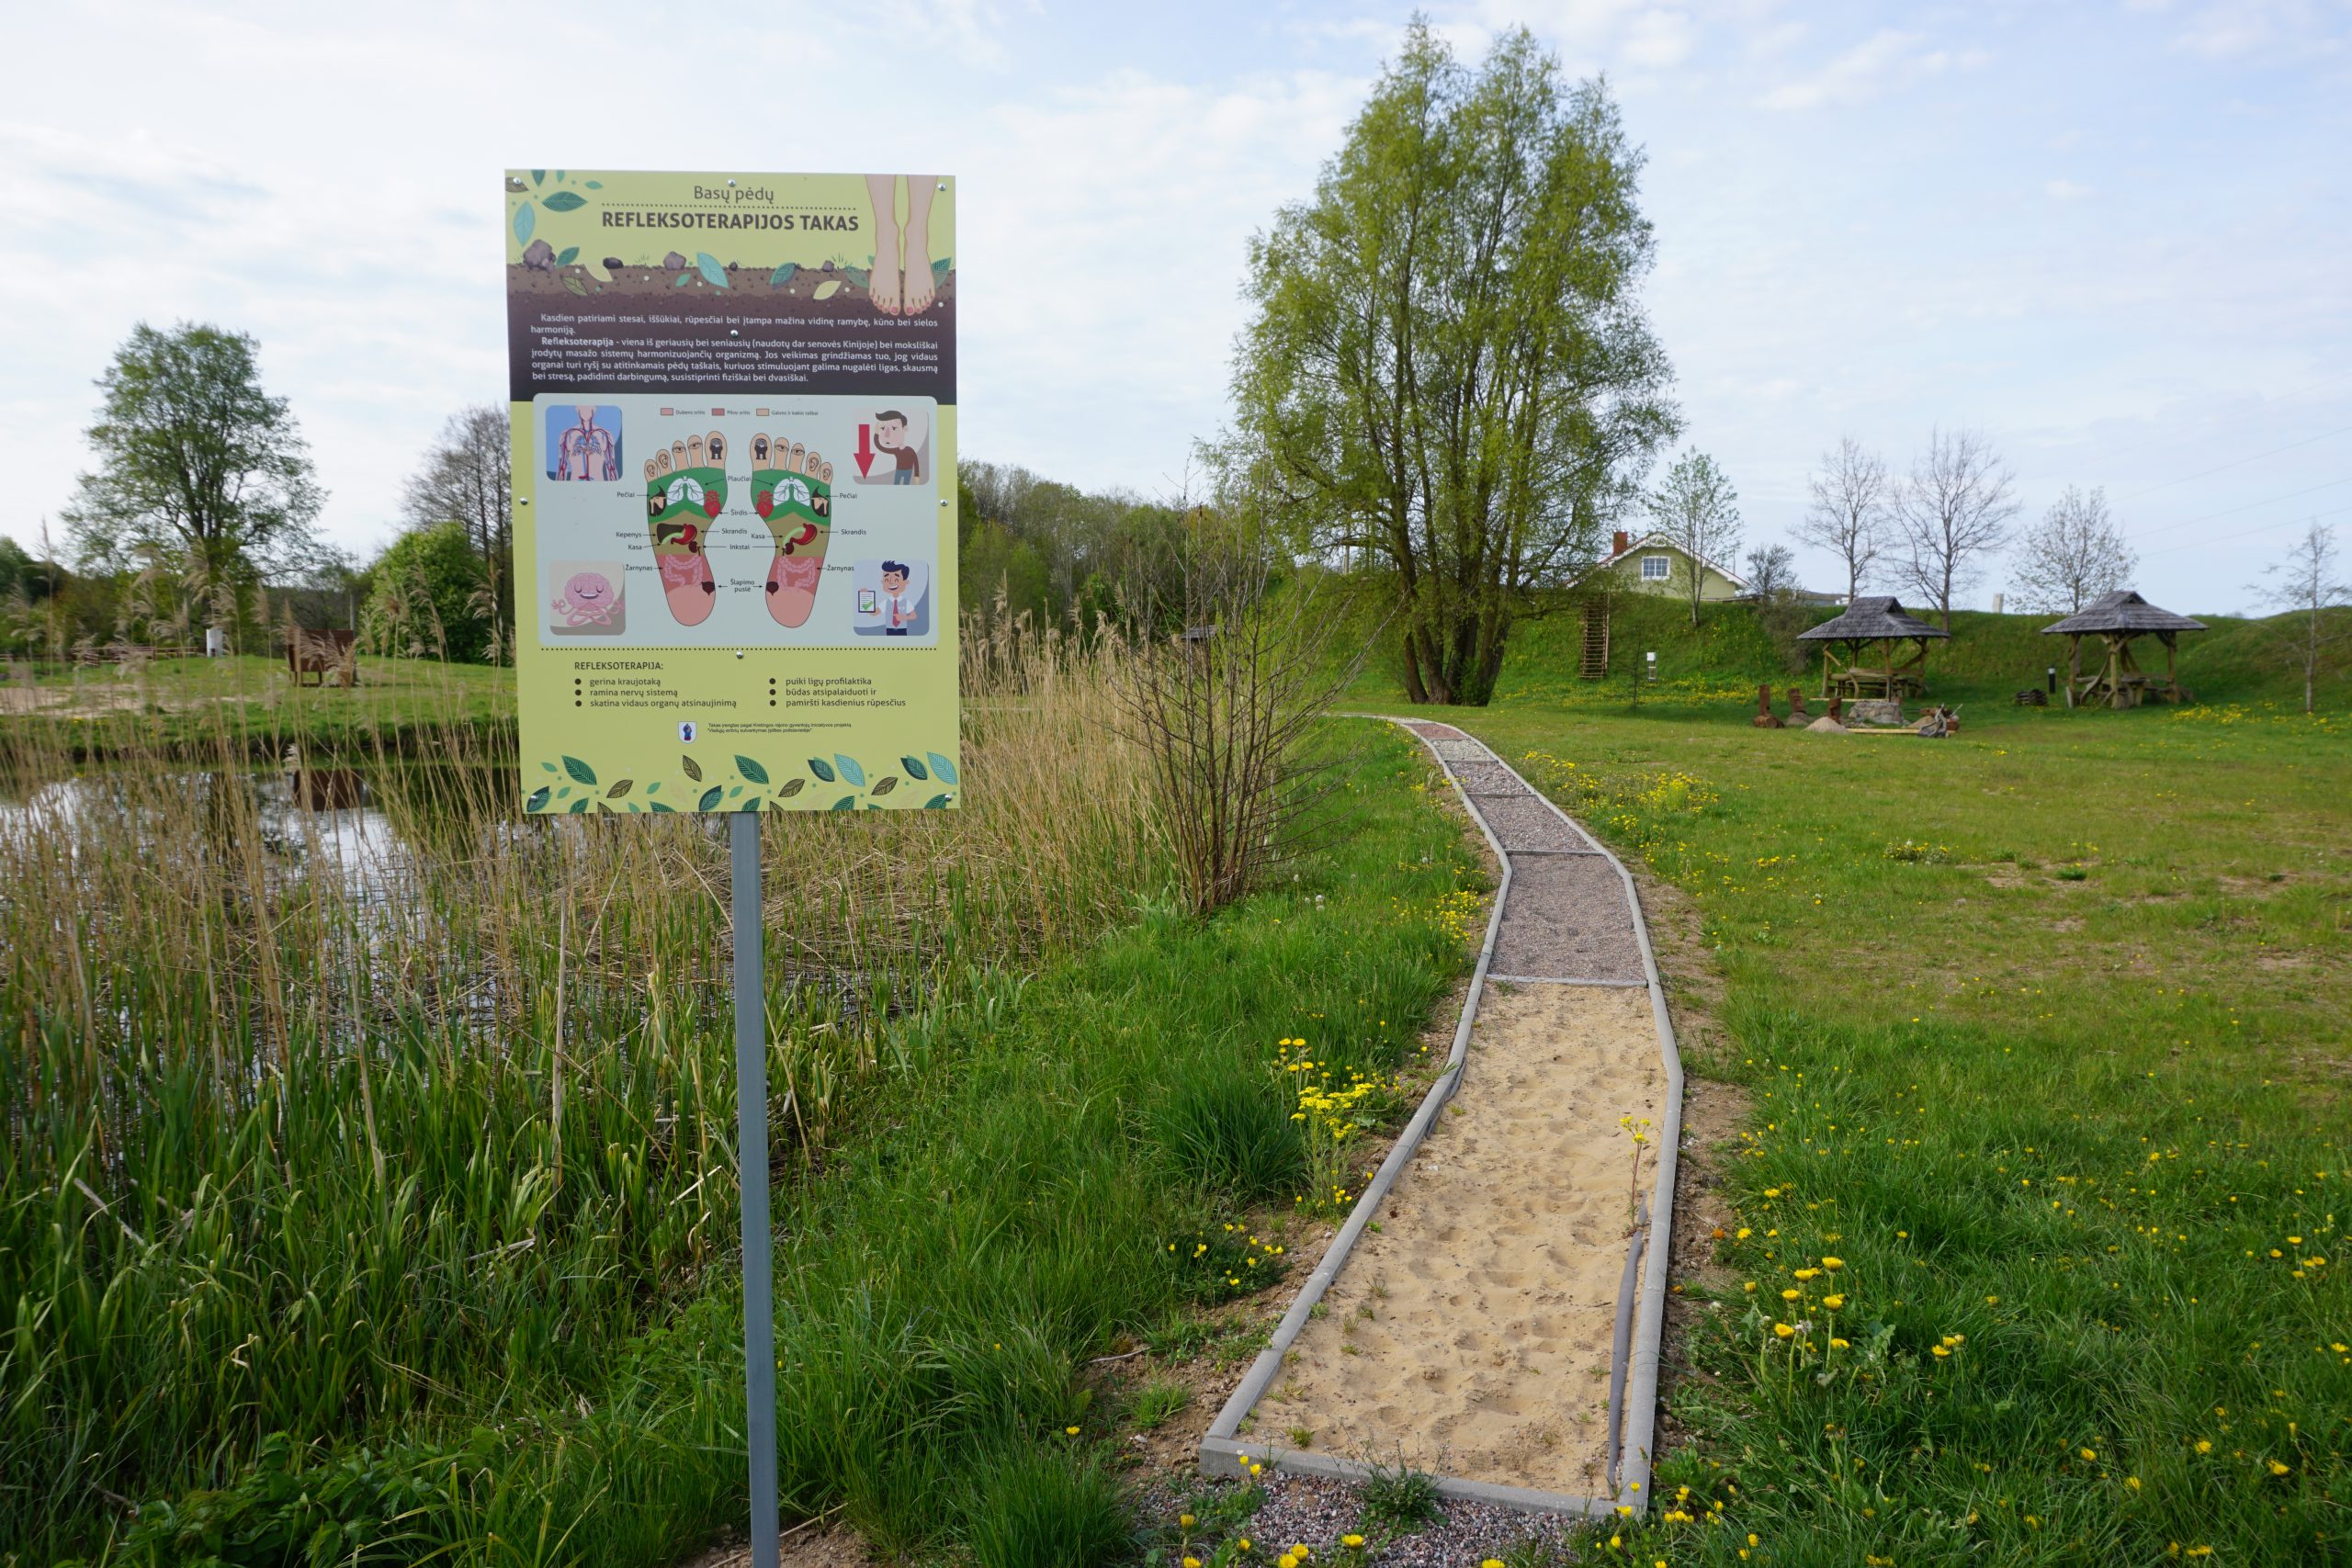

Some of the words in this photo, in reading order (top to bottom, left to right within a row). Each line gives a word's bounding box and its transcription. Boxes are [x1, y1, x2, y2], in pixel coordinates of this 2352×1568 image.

[694, 186, 729, 202] Basų
[736, 187, 774, 204] pėdų
[602, 211, 793, 229] REFLEKSOTERAPIJOS
[799, 215, 858, 230] TAKAS
[577, 314, 615, 323] patiriami
[619, 315, 645, 323] stesai,
[649, 315, 681, 323] iššūkiai,
[685, 316, 722, 325] rūpesčiai
[743, 316, 771, 325] įtampa
[808, 317, 833, 327] vidinę
[837, 318, 870, 327] ramybę,
[530, 325, 576, 335] harmoniją.
[541, 336, 613, 347] Refleksoterapija
[655, 338, 693, 348] geriausių
[711, 339, 750, 348] seniausių
[752, 339, 789, 349] (naudotų
[843, 340, 877, 349] Kinijoje)
[531, 348, 561, 358] įrodytų
[601, 349, 633, 359] sistemų
[637, 349, 711, 359] harmonizuojančių
[715, 351, 760, 360] organizmą.
[821, 351, 871, 361] grindžiamas
[894, 352, 907, 362] jog
[532, 361, 563, 370] organai
[584, 361, 598, 370] ryšį
[667, 361, 688, 371] pėdų
[691, 361, 721, 370] taškais,
[757, 362, 809, 371] stimuluojant
[812, 363, 839, 372] galima
[842, 363, 875, 372] nugalėti
[879, 363, 900, 373] ligas,
[903, 364, 937, 373] skausmą
[548, 373, 574, 381] stresą,
[577, 372, 614, 381] padidinti
[617, 372, 669, 382] darbingumą,
[671, 373, 719, 382] susistiprinti
[589, 678, 615, 687] gerina
[618, 678, 660, 687] kraujotaką
[786, 677, 805, 686] puiki
[808, 677, 823, 686] ligų
[825, 677, 871, 686] profilaktika
[646, 688, 677, 697] sistemą
[813, 688, 867, 697] atsipalaiduoti
[681, 699, 736, 708] atsinaujinimą
[786, 699, 819, 707] pamiršti
[867, 699, 905, 707] rūpesčius
